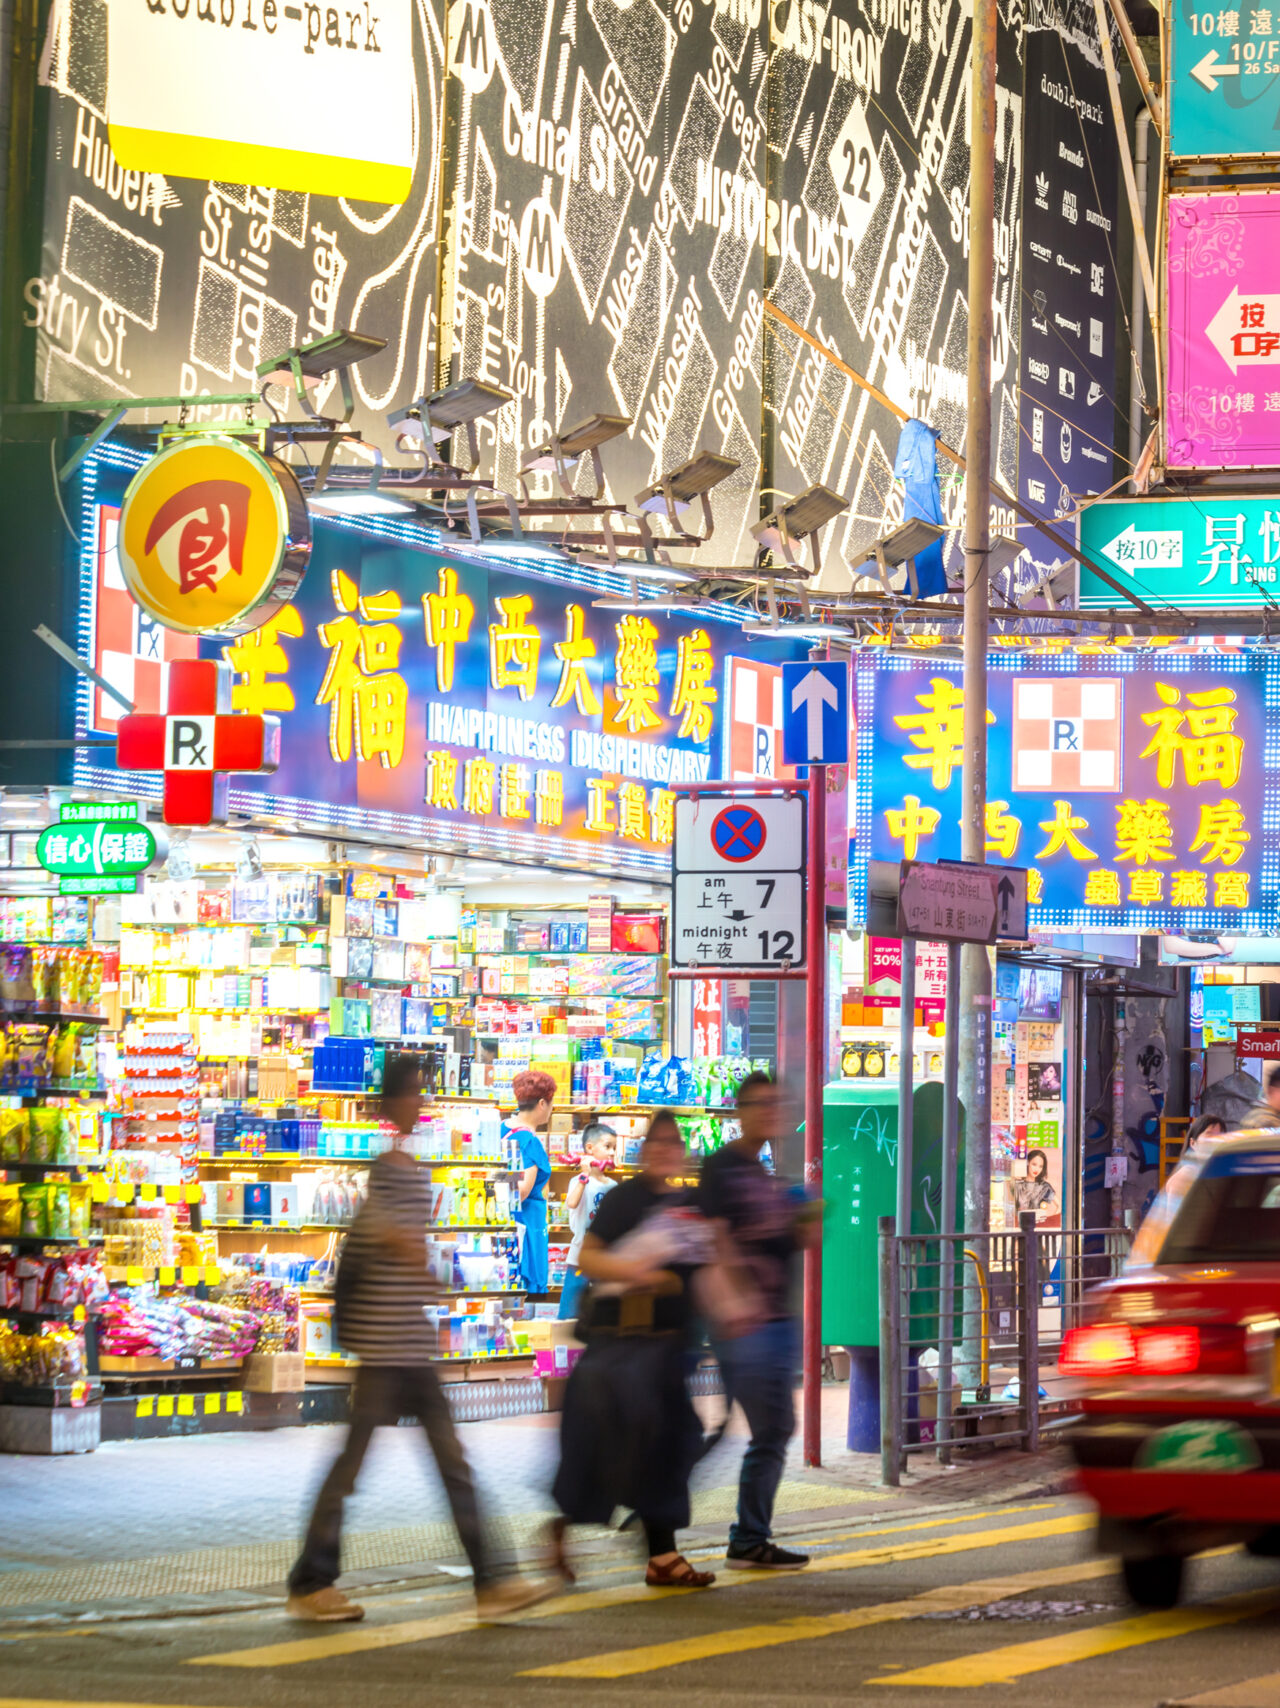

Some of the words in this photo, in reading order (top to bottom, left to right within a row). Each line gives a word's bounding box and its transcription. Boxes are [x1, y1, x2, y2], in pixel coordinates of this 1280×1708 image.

[146, 0, 381, 53] ouble-park
[1189, 11, 1241, 37] 10樓
[1231, 40, 1280, 62] 10/F
[1244, 62, 1261, 75] 26
[1041, 73, 1104, 125] double-park
[600, 61, 658, 197] Grand
[1059, 141, 1084, 169] Brands
[842, 139, 872, 204] 22
[1063, 189, 1077, 208] ANTI
[601, 226, 648, 342] West
[1240, 303, 1265, 328] 按
[95, 303, 131, 378] St.
[641, 275, 702, 457] Wooster
[712, 289, 764, 436] Greene
[1209, 391, 1256, 414] 10樓
[1116, 539, 1180, 561] 按10字
[170, 720, 208, 766] Rx
[427, 701, 566, 764] HAPPINESS
[569, 729, 711, 784] DISPENSARY
[1139, 682, 1246, 791] 福
[424, 749, 564, 827] 政府註冊
[697, 892, 734, 910] 上午
[755, 879, 776, 909] 7
[704, 878, 726, 888] am
[682, 925, 748, 940] midnight
[697, 943, 734, 960] 午夜
[758, 929, 795, 960] 12
[873, 954, 901, 966] 30%
